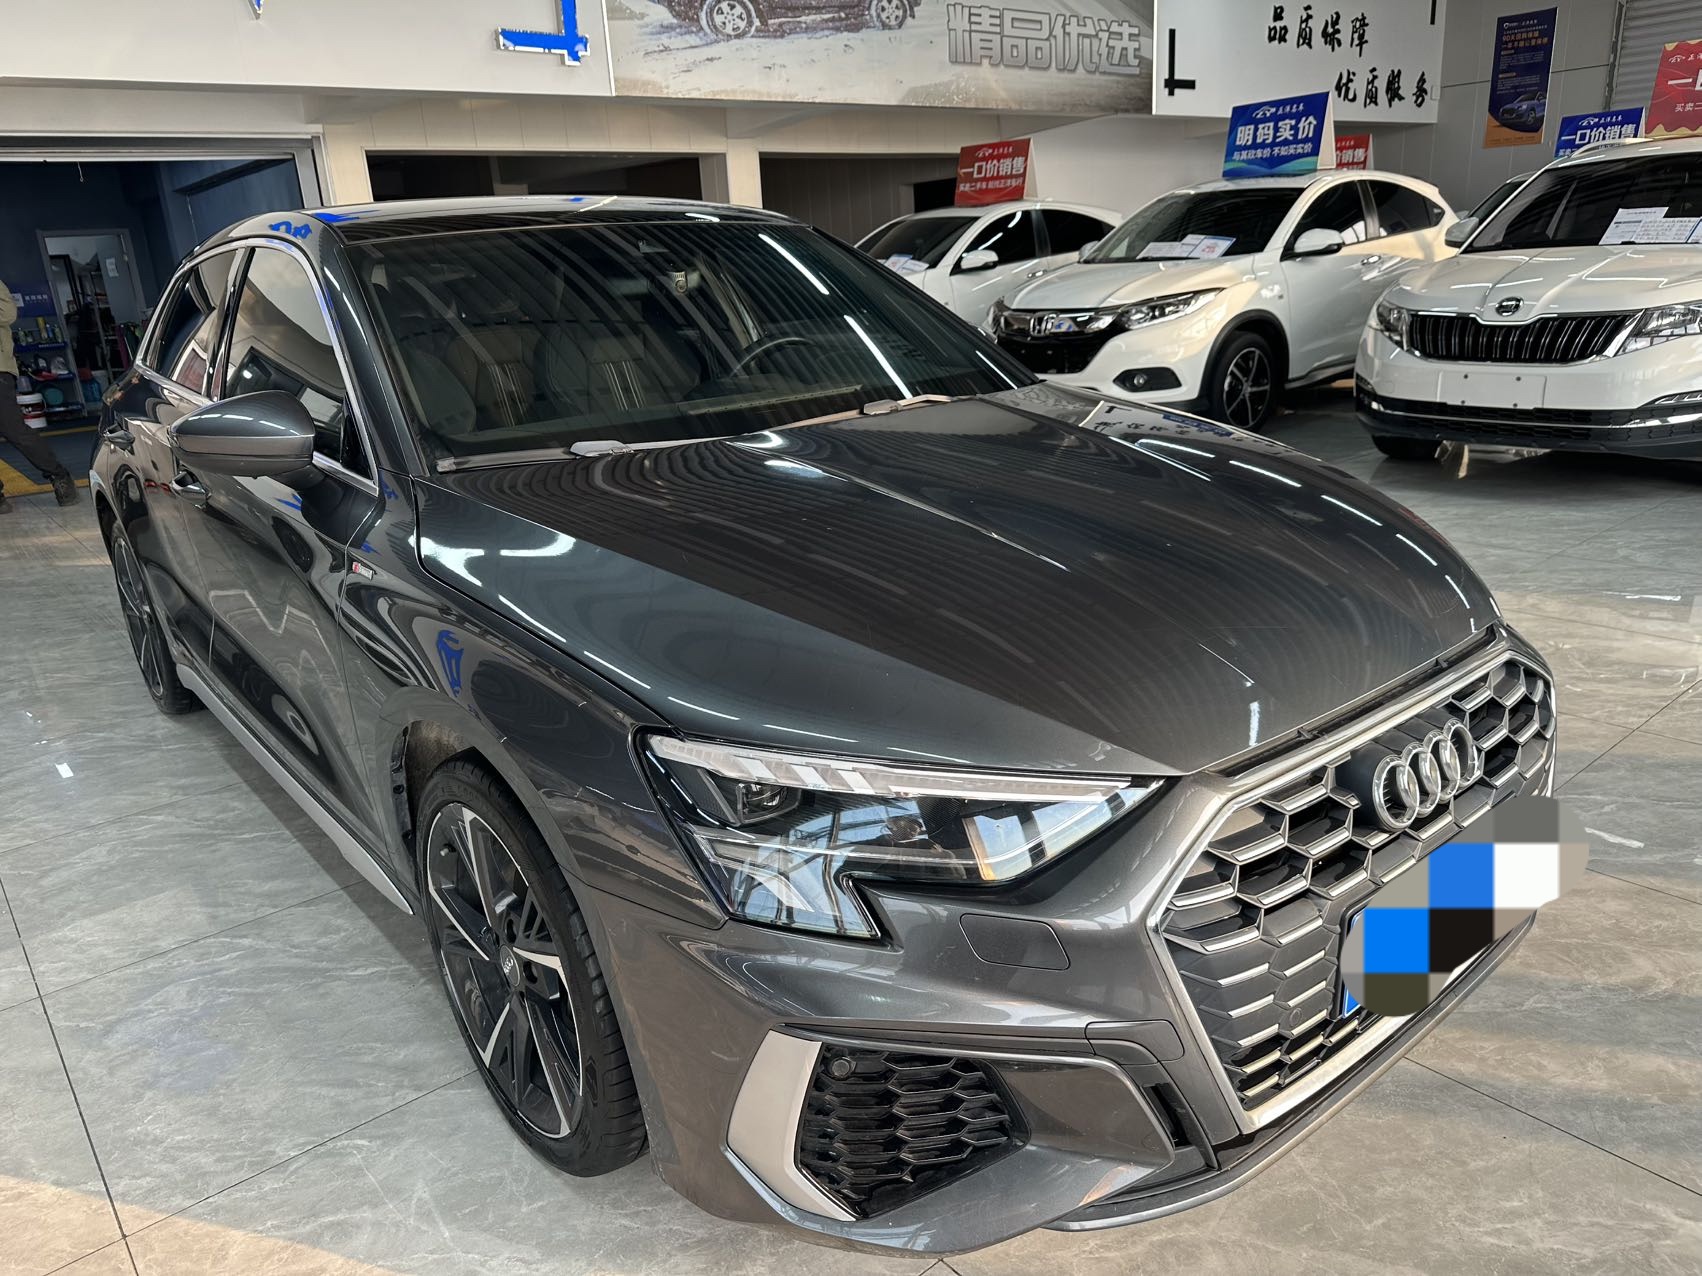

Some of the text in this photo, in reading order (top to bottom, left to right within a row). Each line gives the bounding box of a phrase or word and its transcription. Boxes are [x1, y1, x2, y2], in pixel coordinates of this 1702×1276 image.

[947, 4, 1142, 75] 精品优选
[1267, 5, 1370, 57] 品质保障
[1335, 67, 1429, 108] 优质服务
[1235, 115, 1317, 146] 明码实价
[1561, 124, 1636, 144] 一口价销售
[960, 156, 1025, 178] 一口价销售
